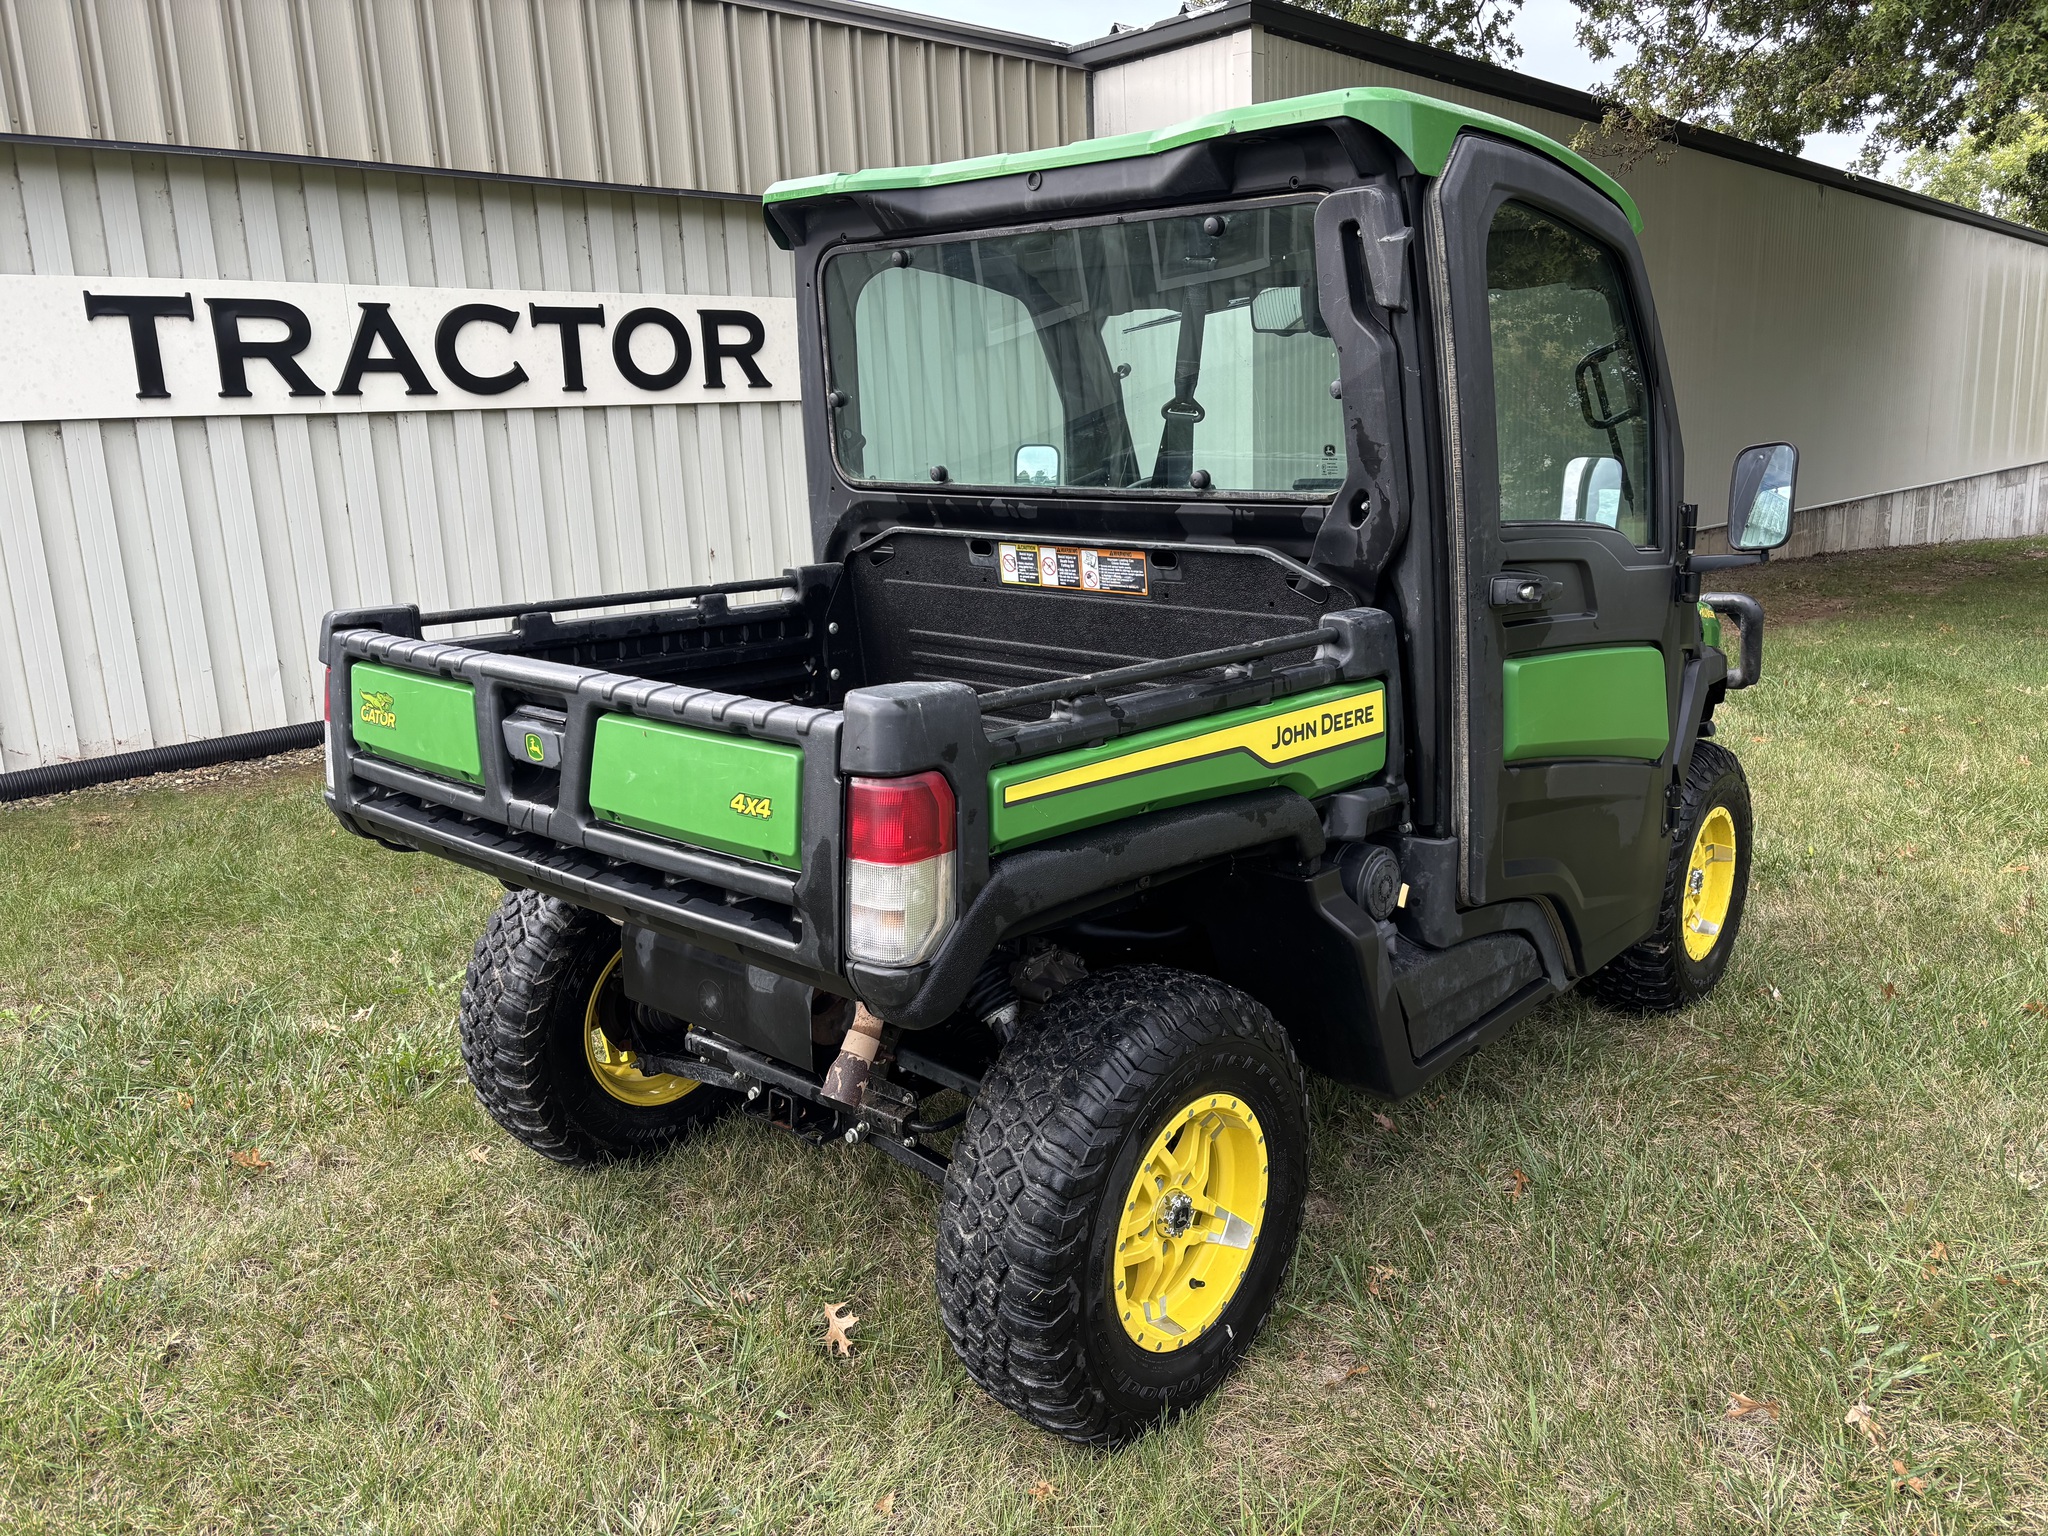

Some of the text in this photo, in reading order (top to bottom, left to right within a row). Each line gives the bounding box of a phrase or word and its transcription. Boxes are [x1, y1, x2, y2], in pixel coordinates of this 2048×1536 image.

[83, 290, 773, 399] TRACTOR
[360, 702, 396, 729] GATOR
[1271, 705, 1374, 750] JOHN DEERE
